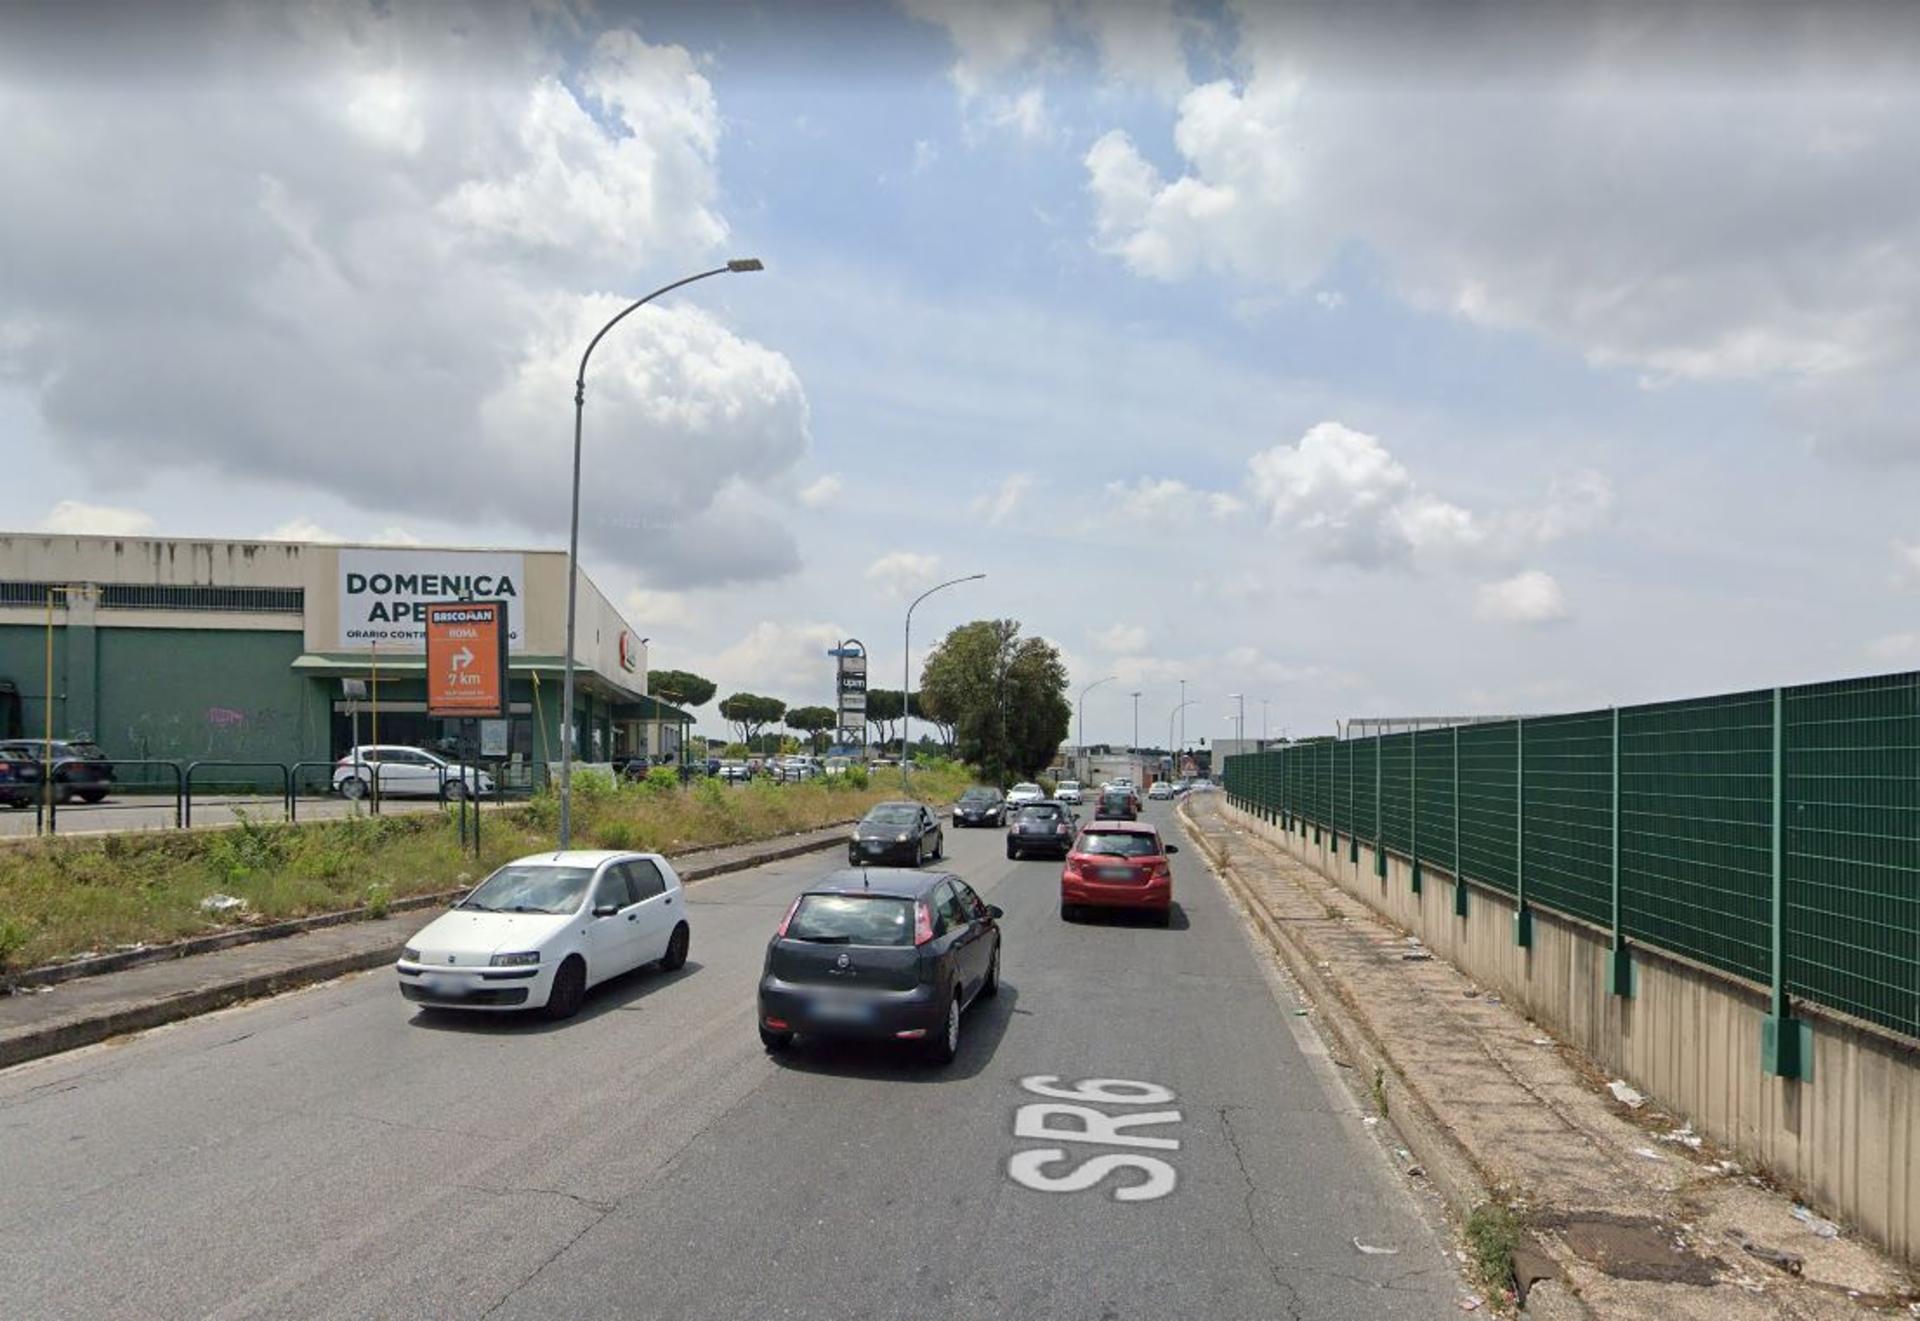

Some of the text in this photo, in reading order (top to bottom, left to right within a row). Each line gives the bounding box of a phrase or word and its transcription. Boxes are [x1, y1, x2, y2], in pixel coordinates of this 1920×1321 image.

[347, 573, 517, 597] DOMENICA
[368, 601, 427, 622] APE
[433, 611, 493, 622] BRICOMAN
[346, 630, 388, 639] ORARIO
[448, 672, 481, 687] 7 km
